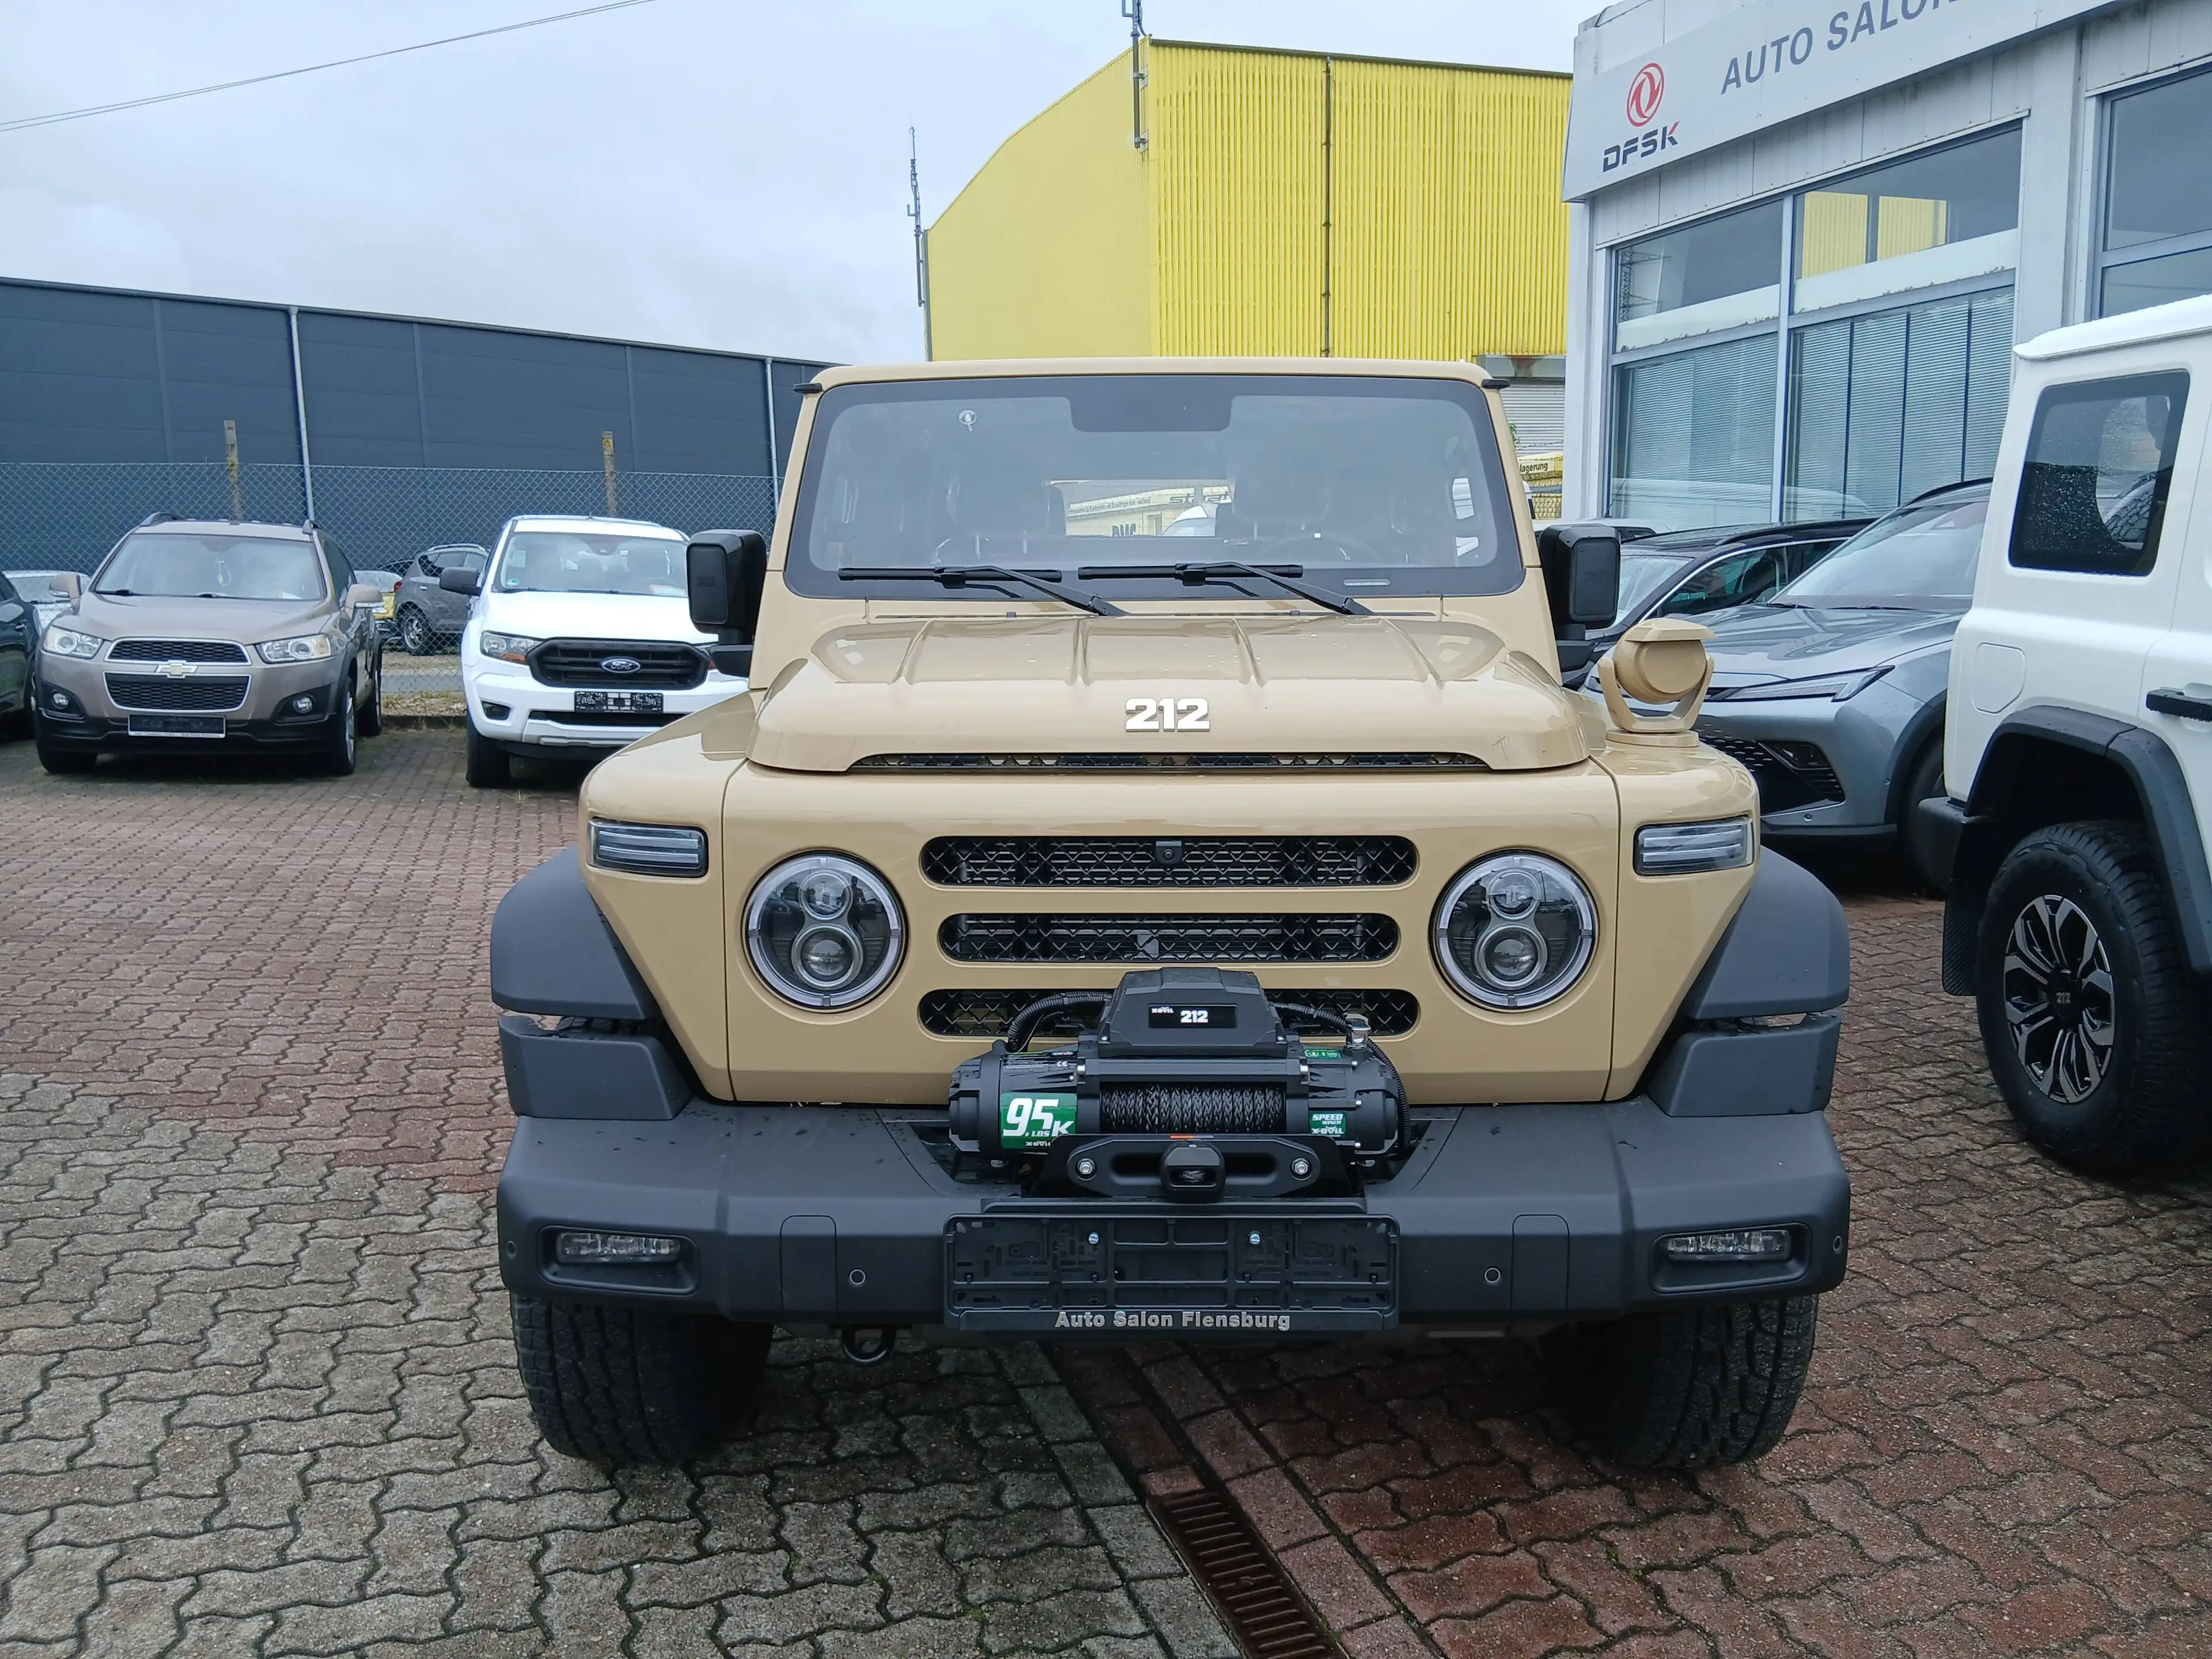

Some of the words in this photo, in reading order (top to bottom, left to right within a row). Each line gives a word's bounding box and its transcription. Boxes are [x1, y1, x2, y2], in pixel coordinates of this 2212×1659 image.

[1721, 27, 1813, 94] AUTO
[1827, 0, 1957, 51] SALO
[1603, 120, 1680, 172] DFSK
[611, 661, 632, 670] Ford
[1125, 698, 1210, 732] 212
[1180, 1010, 1209, 1023] 212
[1055, 1312, 1105, 1328] Auto
[1113, 1310, 1173, 1328] Salon
[1181, 1311, 1290, 1331] Flensburg
